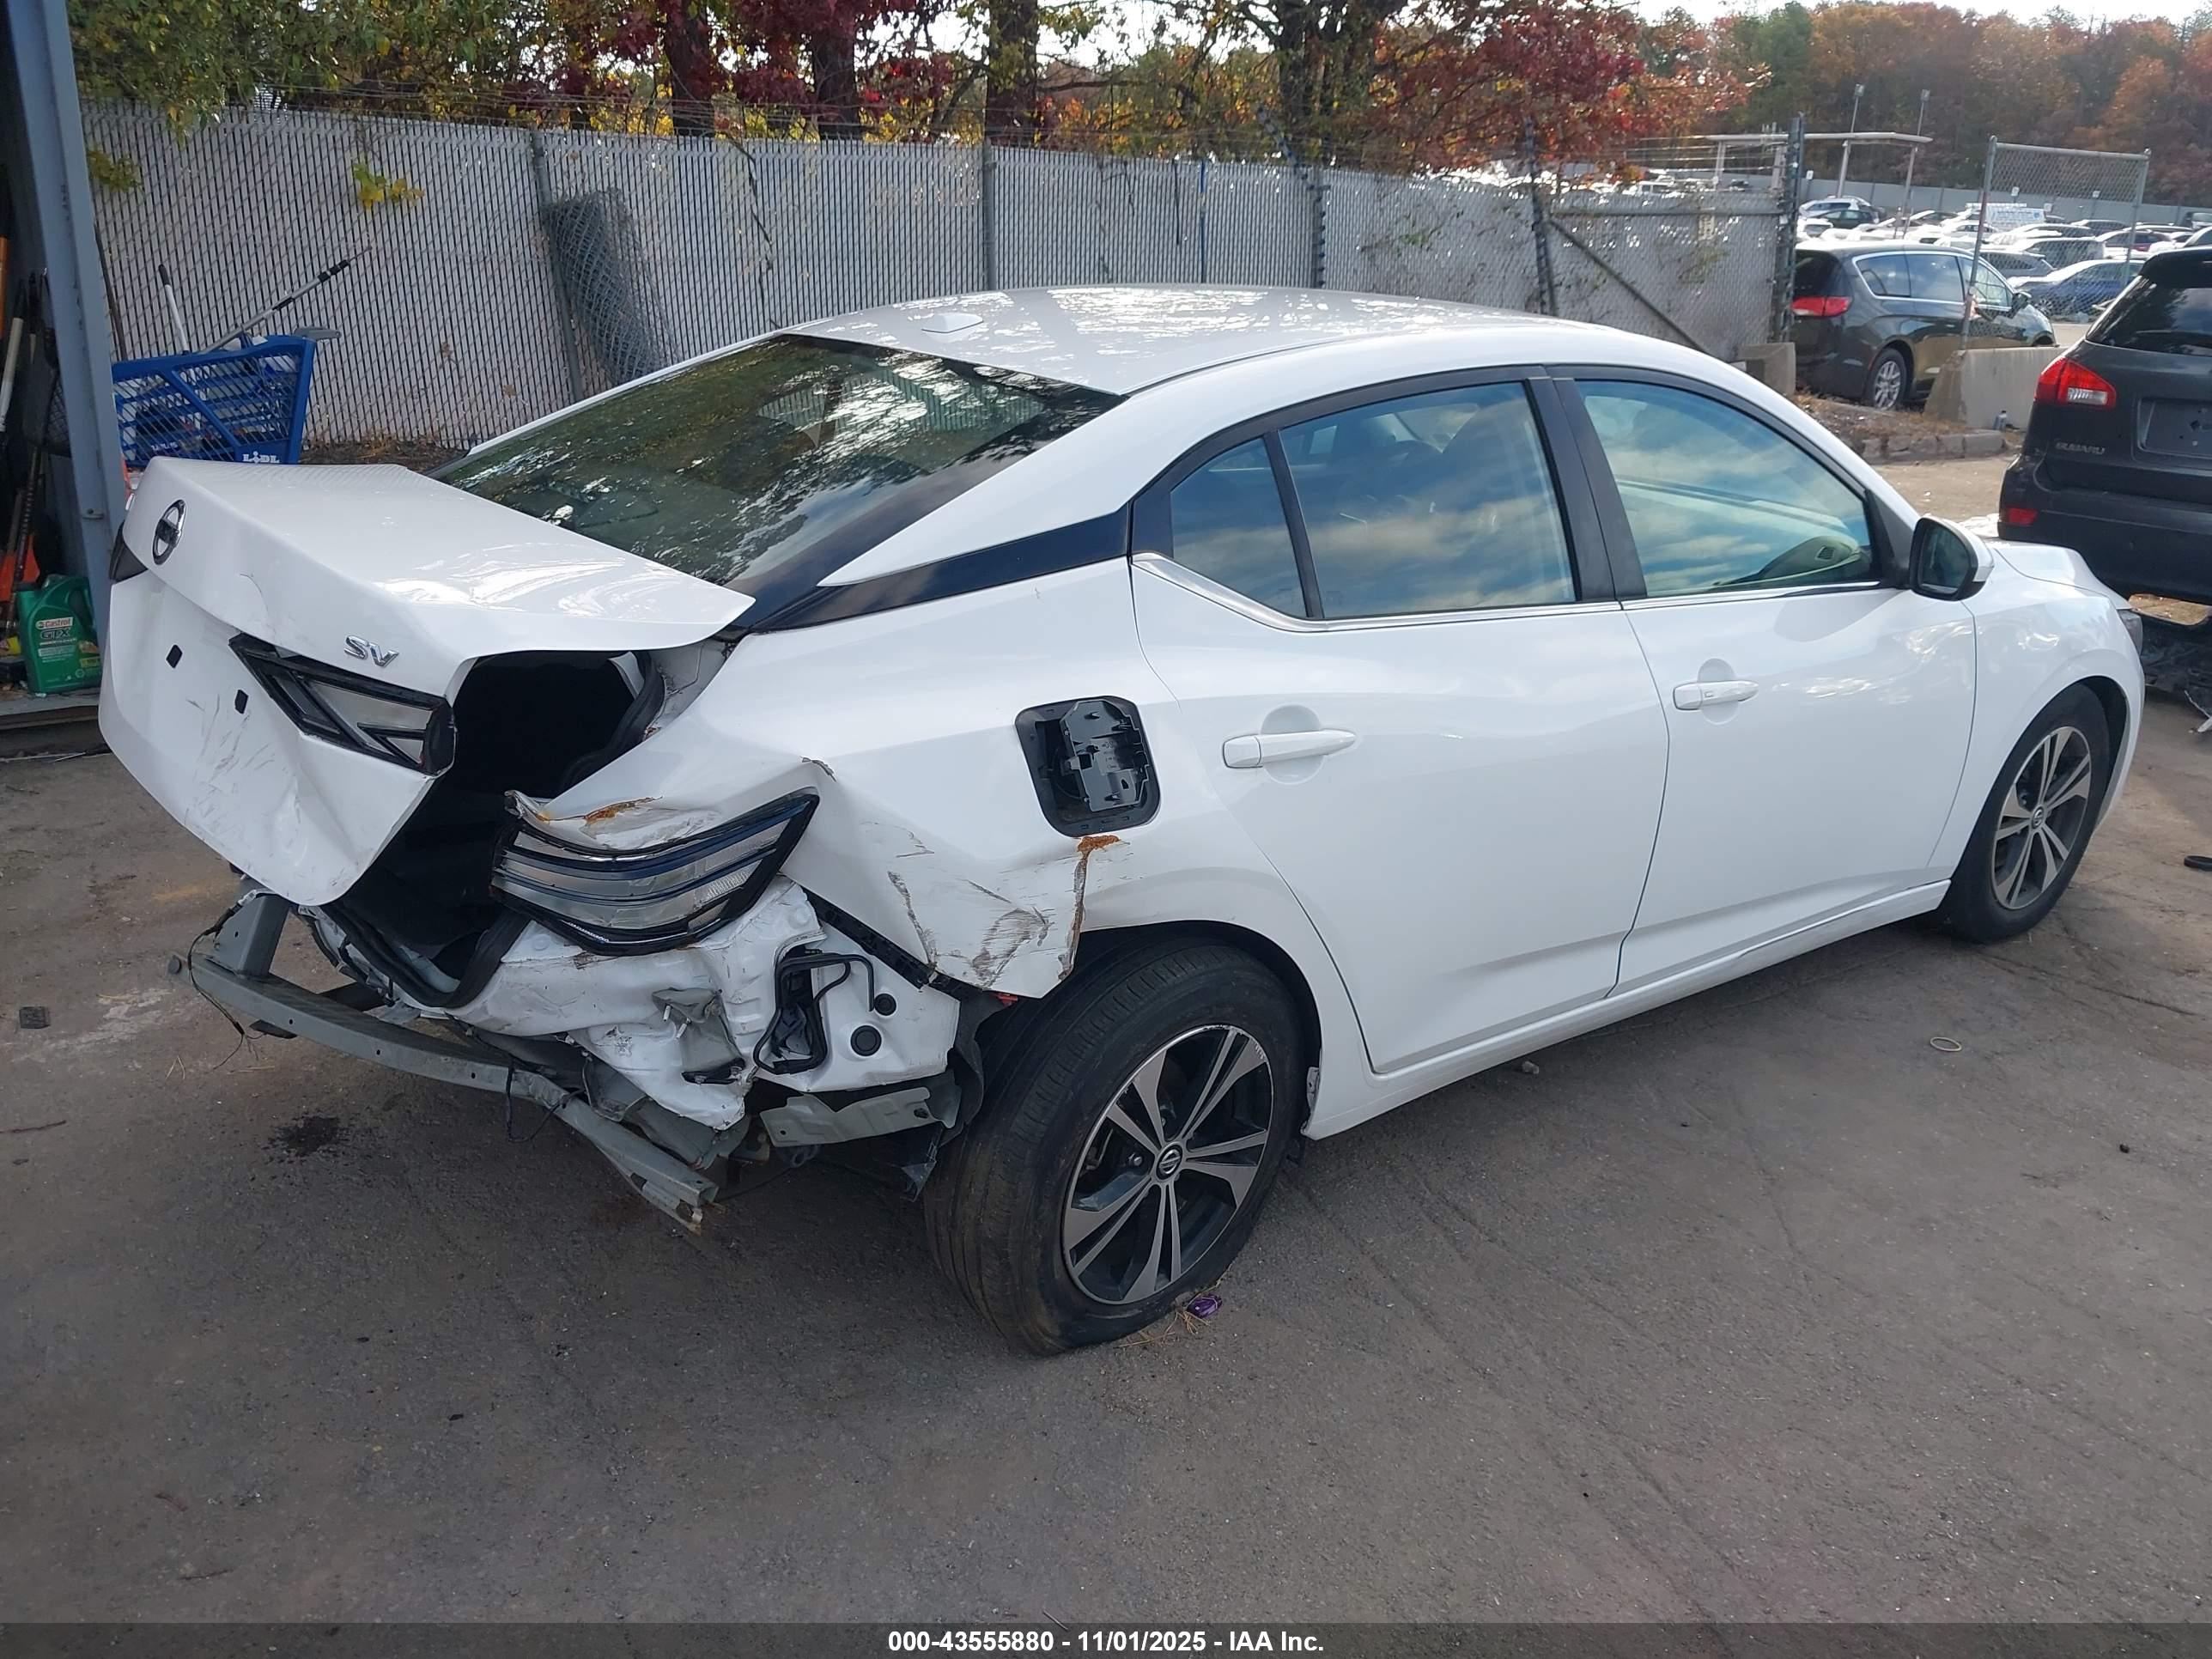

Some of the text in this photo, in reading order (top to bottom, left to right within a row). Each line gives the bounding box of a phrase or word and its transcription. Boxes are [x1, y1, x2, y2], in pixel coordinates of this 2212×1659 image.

[45, 618, 71, 629] Castrol
[40, 629, 70, 640] GTX
[343, 635, 399, 667] SV
